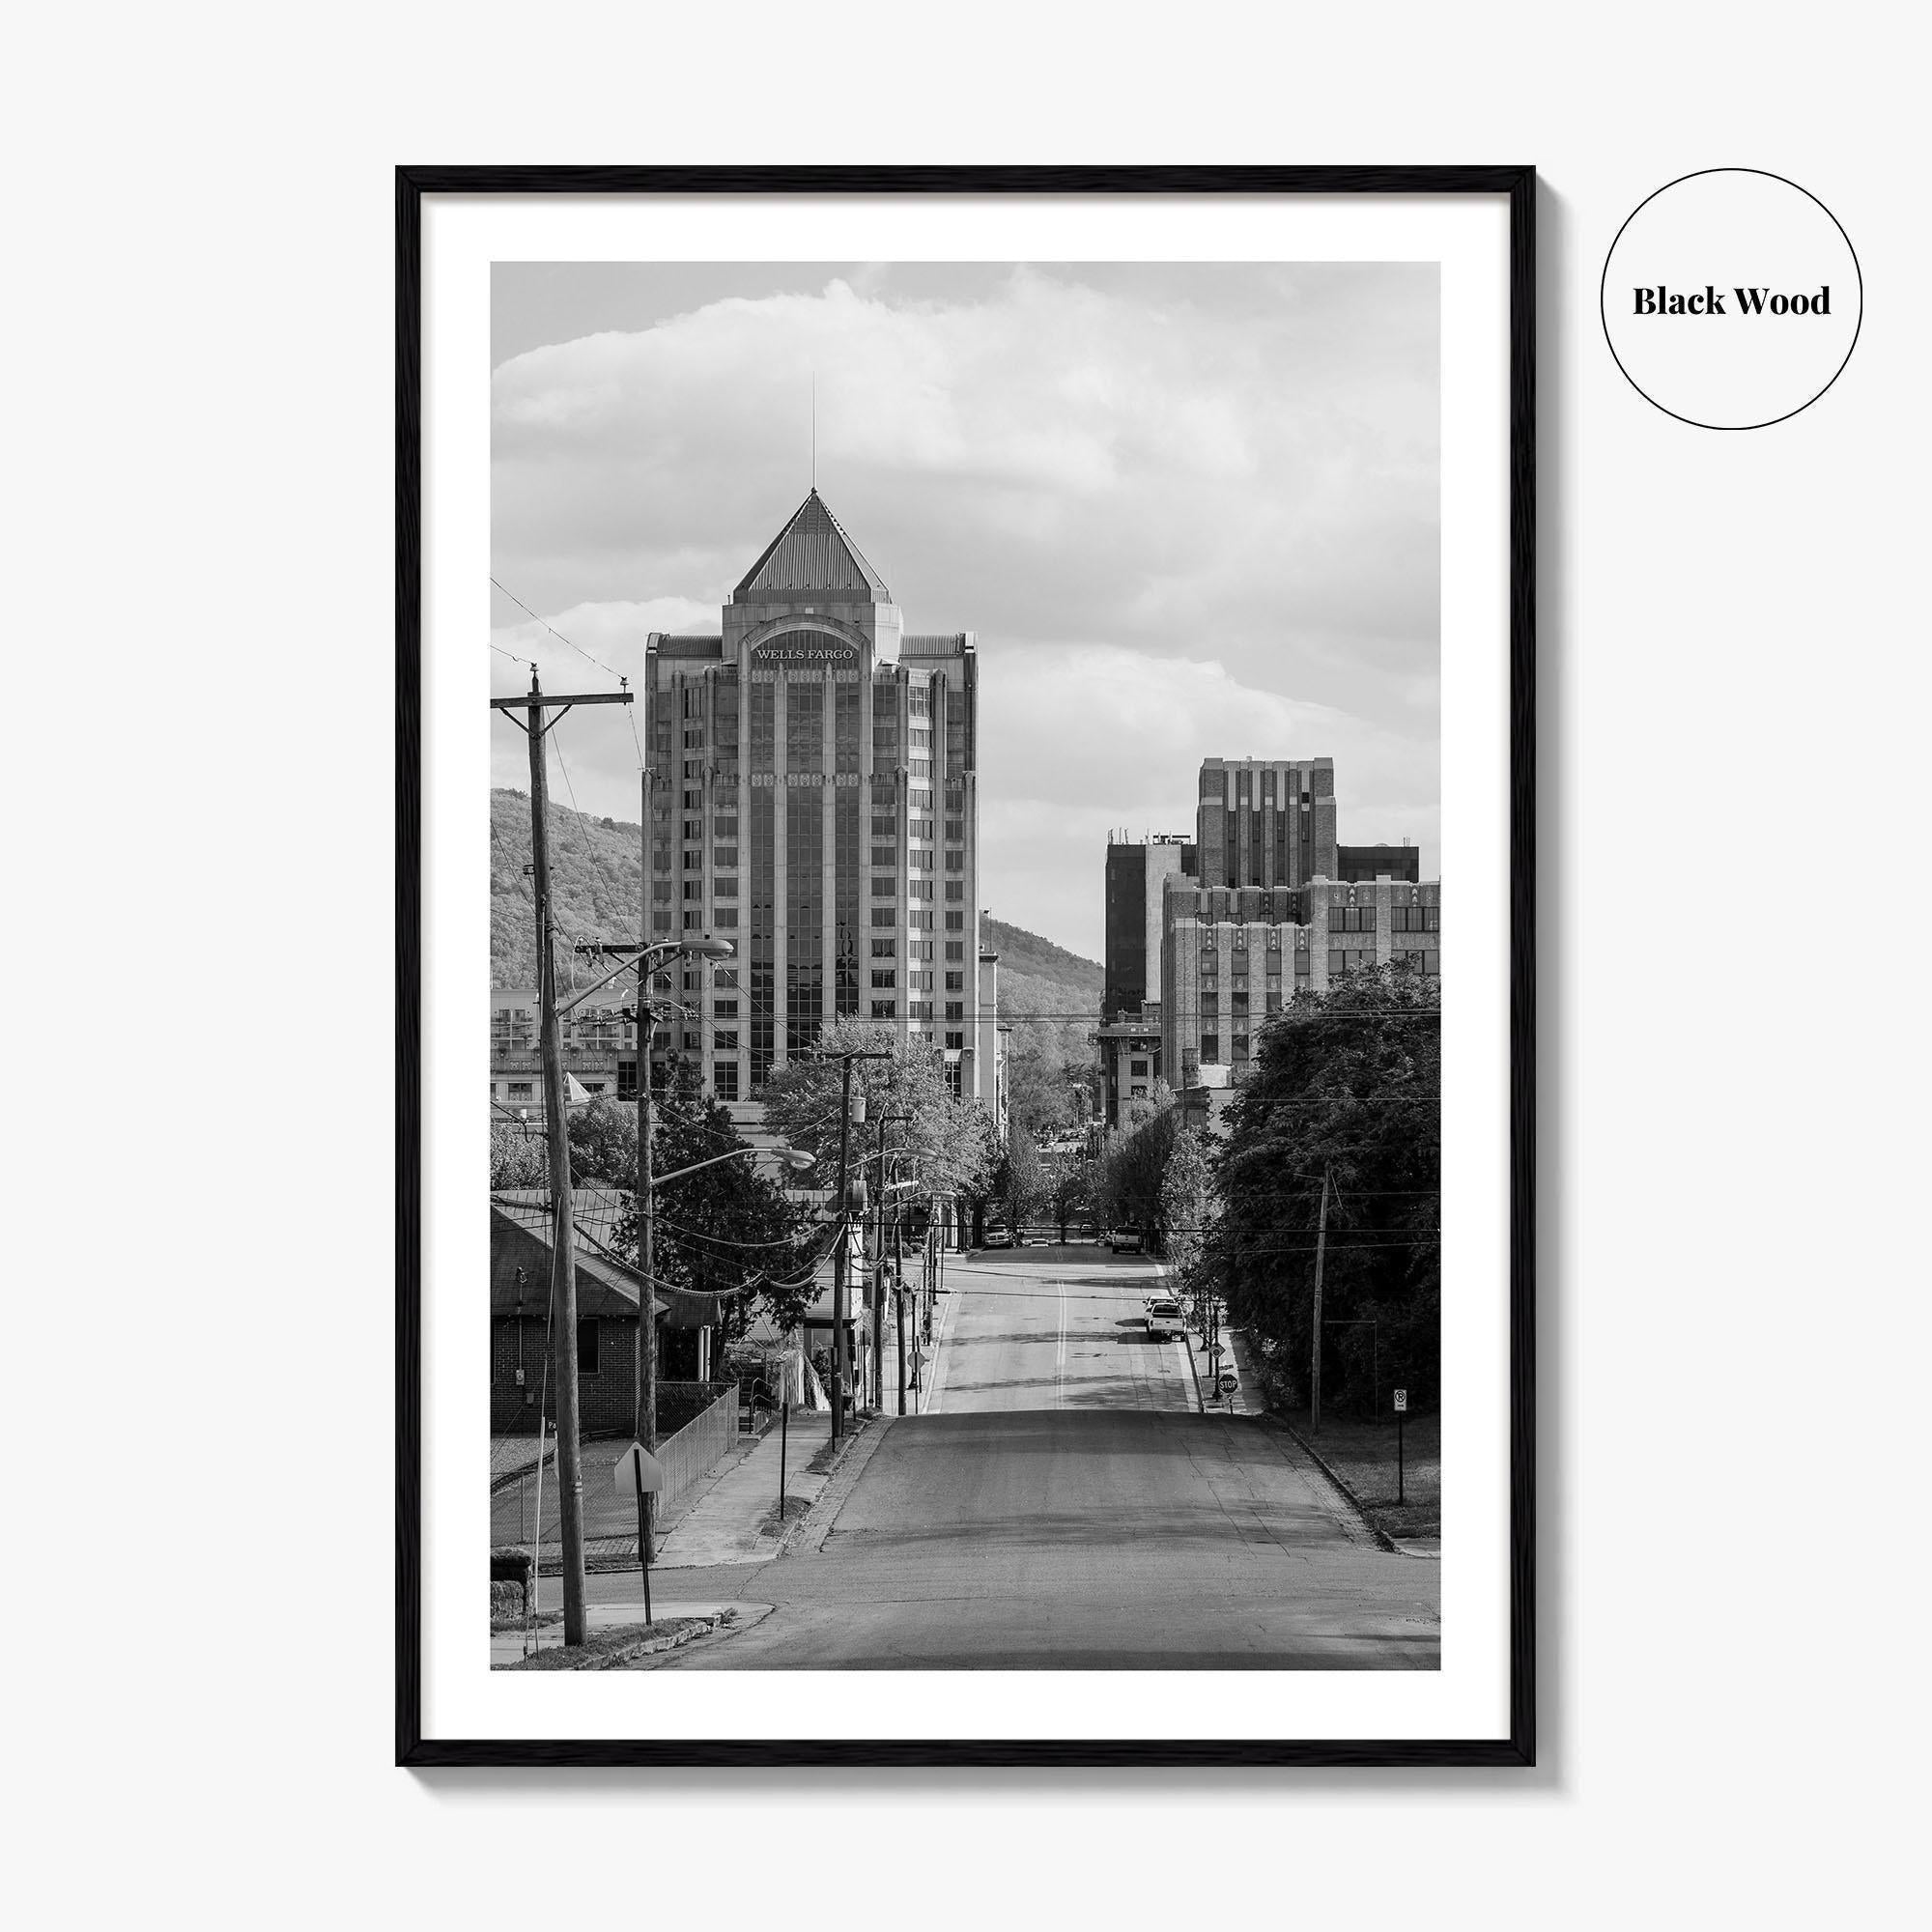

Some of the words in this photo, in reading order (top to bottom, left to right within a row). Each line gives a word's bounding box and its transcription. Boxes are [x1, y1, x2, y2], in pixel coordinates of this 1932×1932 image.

[757, 649, 805, 660] WELLS
[808, 649, 853, 660] FARGO
[1219, 1379, 1237, 1389] STOP
